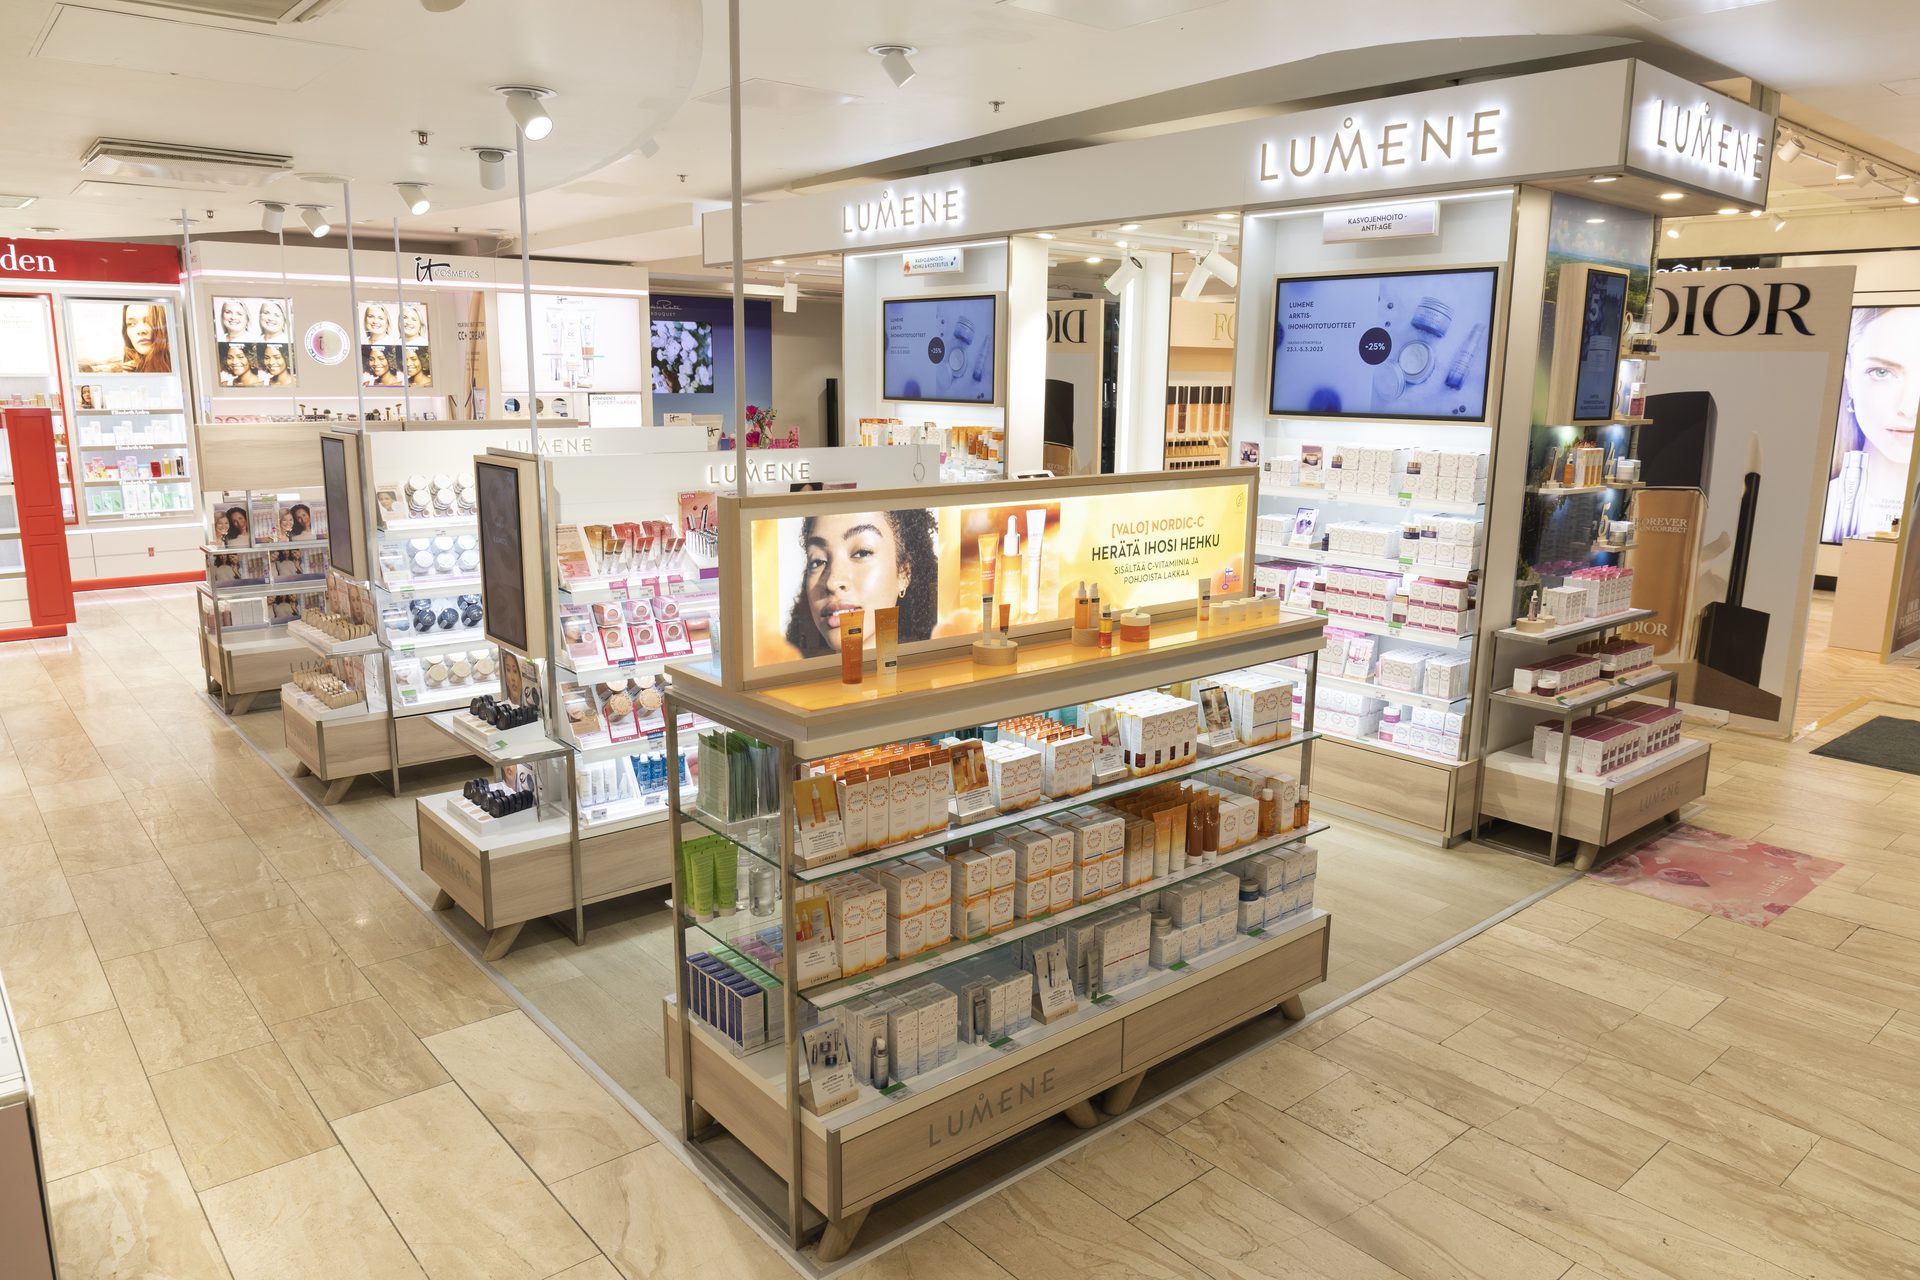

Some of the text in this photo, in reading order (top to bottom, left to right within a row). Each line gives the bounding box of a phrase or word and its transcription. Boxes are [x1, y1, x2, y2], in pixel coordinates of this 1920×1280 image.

[1260, 109, 1500, 181] LUMENE
[1656, 99, 1766, 179] LUMENE
[843, 189, 958, 233] LUMENE
[1348, 213, 1403, 225] KASVOJENHOITO
[1361, 223, 1392, 232] ANTI-AGE
[415, 256, 480, 282] it COSMETICS
[1287, 322, 1356, 330] IHONHOITOTUOTTEET
[1365, 342, 1386, 351] -25%
[505, 435, 593, 454] LUMENE
[709, 457, 812, 485] LUMENE
[1111, 515, 1205, 539] [VALO] NORDIC-C
[1091, 533, 1220, 562] HERÄTÄ IHOSI HEHKU
[1113, 562, 1146, 575] SISÄLTÄÄ
[1123, 569, 1190, 585] POHJOISTA LAKKAA
[1628, 620, 1669, 637] DIOR
[1639, 780, 1681, 812] LUMENE
[1759, 875, 1794, 897] LUMENE
[928, 1066, 1057, 1148] LUMENE
